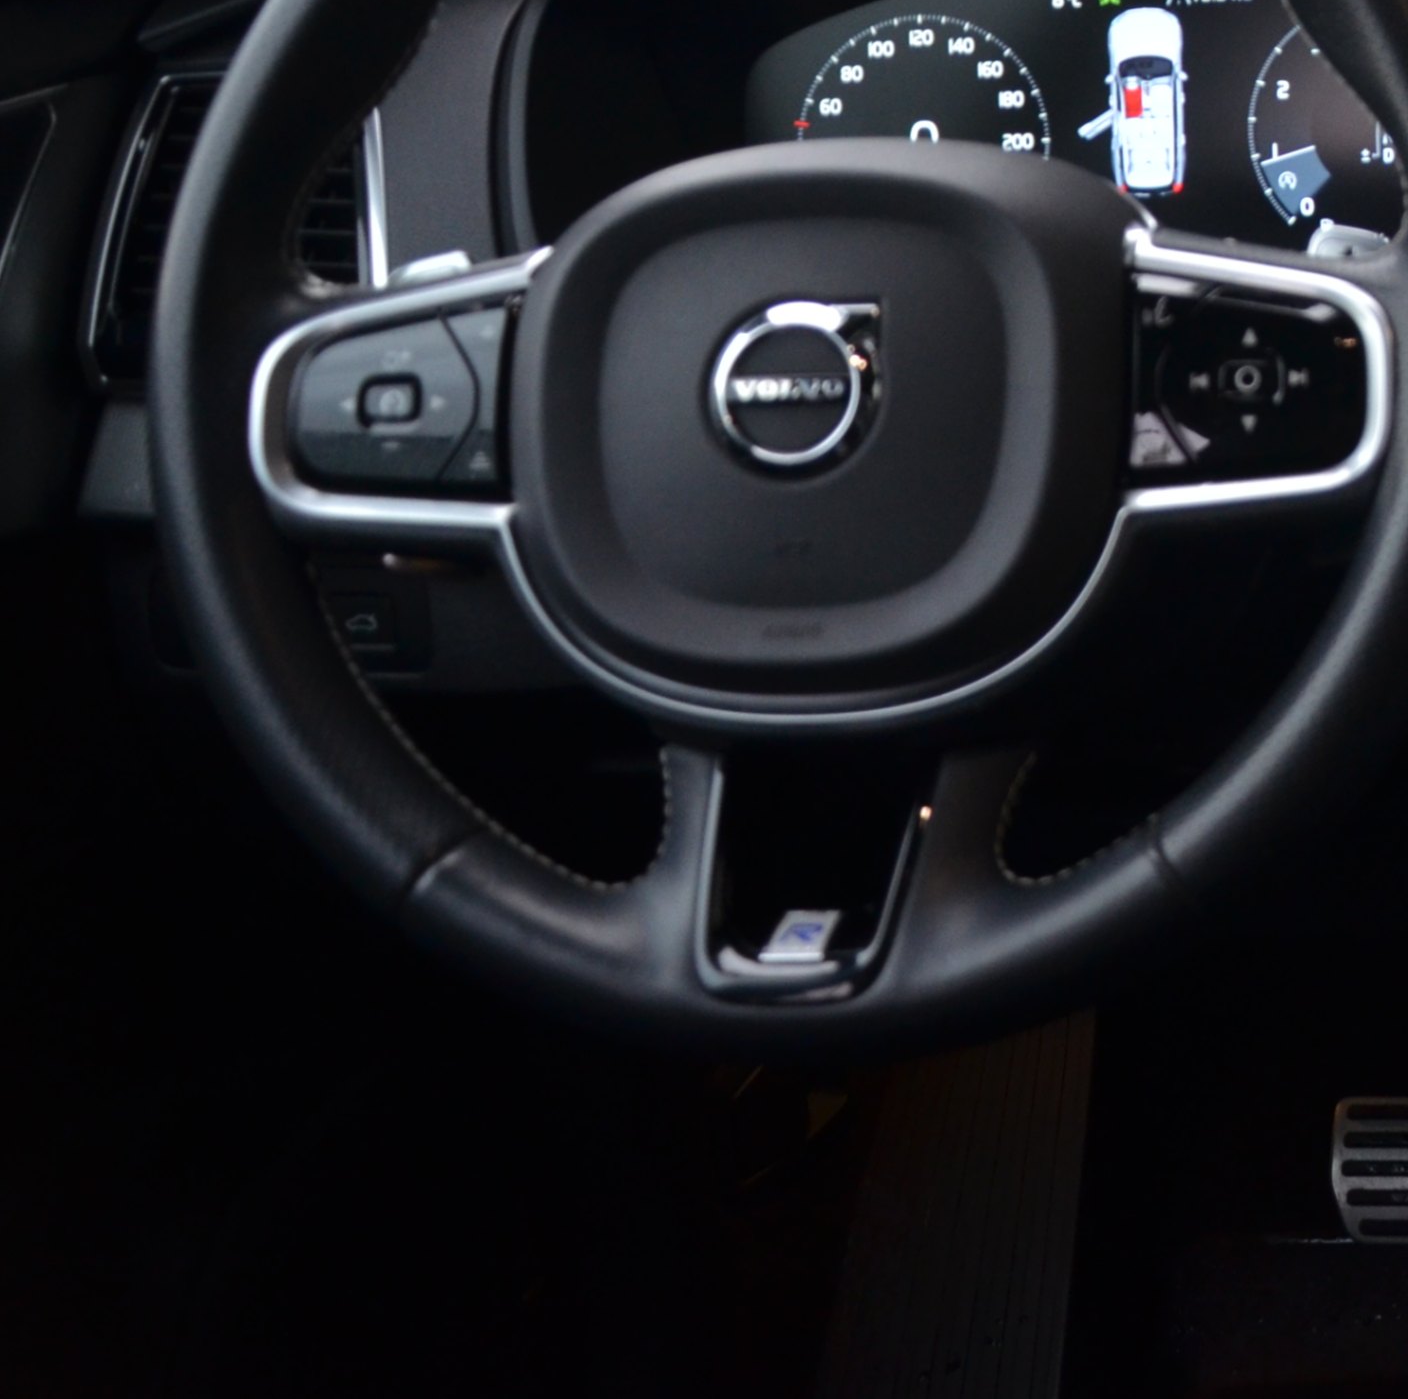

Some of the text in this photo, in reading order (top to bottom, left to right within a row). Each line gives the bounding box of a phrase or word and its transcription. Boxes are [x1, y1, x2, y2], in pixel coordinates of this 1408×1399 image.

[908, 29, 934, 47] 120
[948, 37, 975, 54] 140
[867, 40, 895, 58] 100
[840, 65, 864, 84] 80
[977, 60, 1004, 79] 160
[998, 90, 1025, 108] 180
[1276, 80, 1290, 100] 2
[819, 98, 842, 116] 60
[1002, 132, 1035, 151] 200
[1300, 197, 1315, 217] 0
